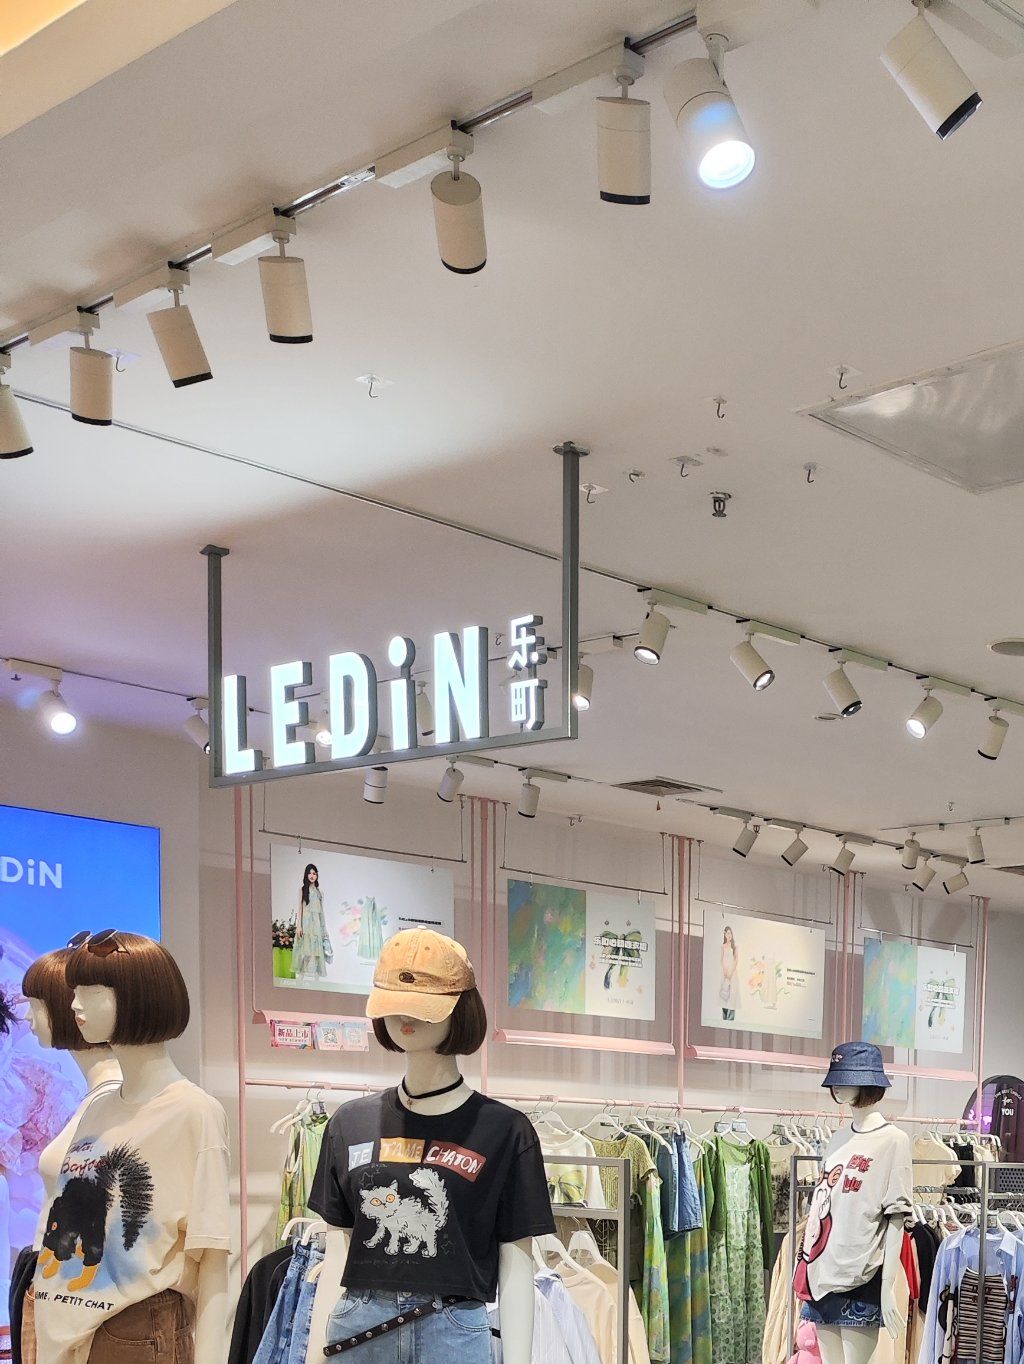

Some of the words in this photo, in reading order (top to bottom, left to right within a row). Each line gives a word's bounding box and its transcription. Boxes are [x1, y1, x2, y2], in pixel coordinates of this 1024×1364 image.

[508, 614, 546, 730] 乐町
[223, 625, 489, 775] LEDiN
[1001, 1108, 1014, 1116] YOU
[351, 1147, 370, 1168] JE
[425, 1145, 482, 1175] CHATON
[85, 1299, 114, 1311] CHAT
